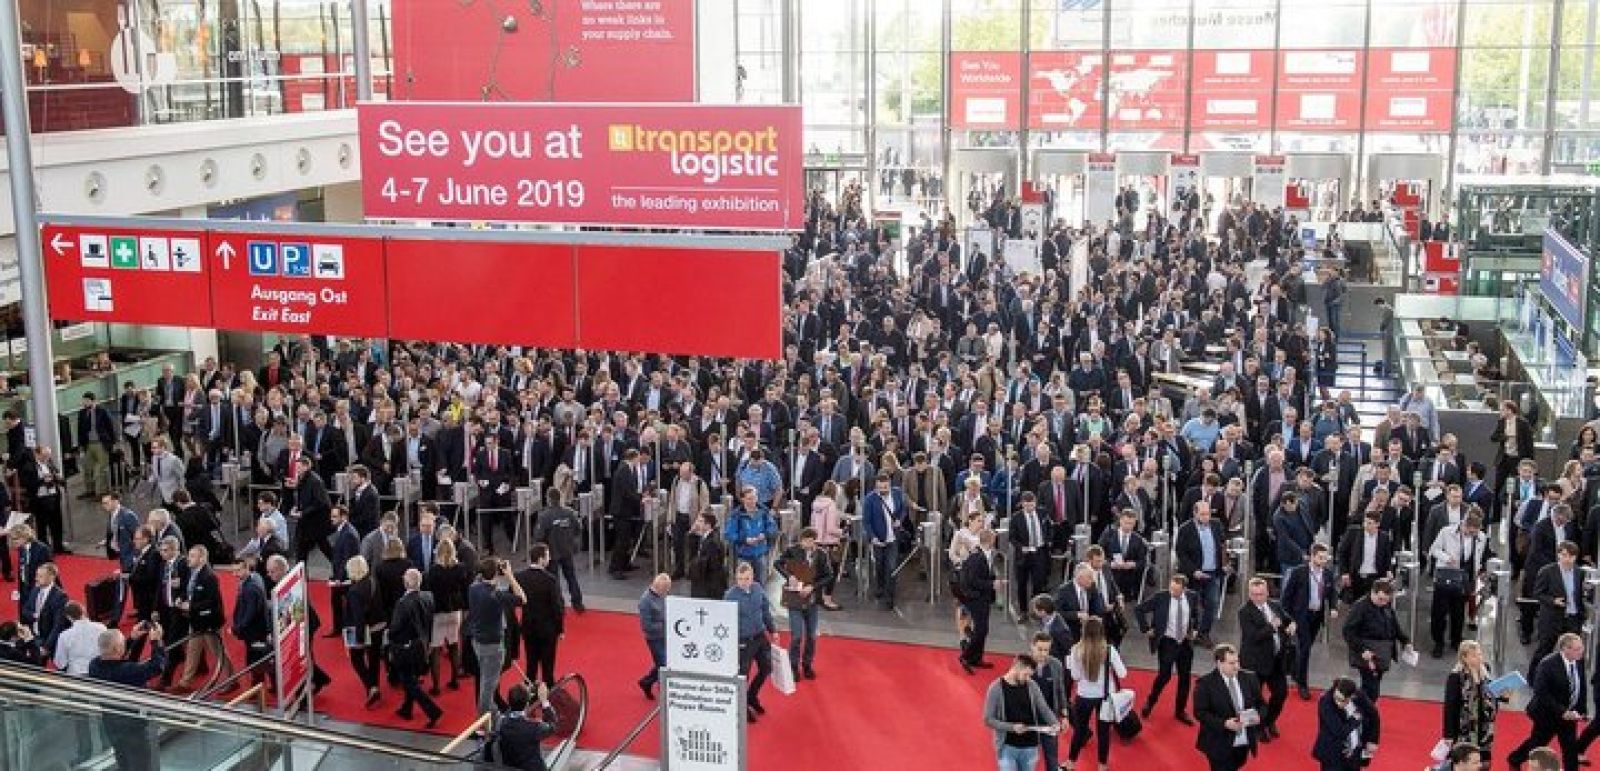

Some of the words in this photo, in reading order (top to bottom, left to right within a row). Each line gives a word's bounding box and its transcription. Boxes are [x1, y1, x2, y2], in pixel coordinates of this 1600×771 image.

[615, 0, 641, 9] there
[597, 15, 624, 24] weak
[626, 14, 651, 24] links
[582, 30, 605, 40] your
[606, 28, 641, 41] supply
[960, 60, 980, 71] See
[378, 119, 450, 157] See
[460, 130, 531, 167] you
[544, 124, 583, 159] at
[635, 125, 778, 152] transport
[670, 149, 779, 184] logistic
[381, 176, 429, 204] 4-7
[438, 177, 508, 206] June
[516, 178, 585, 208] 2019
[612, 194, 637, 209] the
[641, 194, 699, 214] leading
[702, 195, 779, 212] exhibition
[253, 246, 273, 271] U
[283, 246, 300, 273] P
[250, 284, 316, 307] Ausgang
[320, 287, 348, 304] Ost
[252, 306, 279, 321] Exit
[281, 307, 312, 323] East
